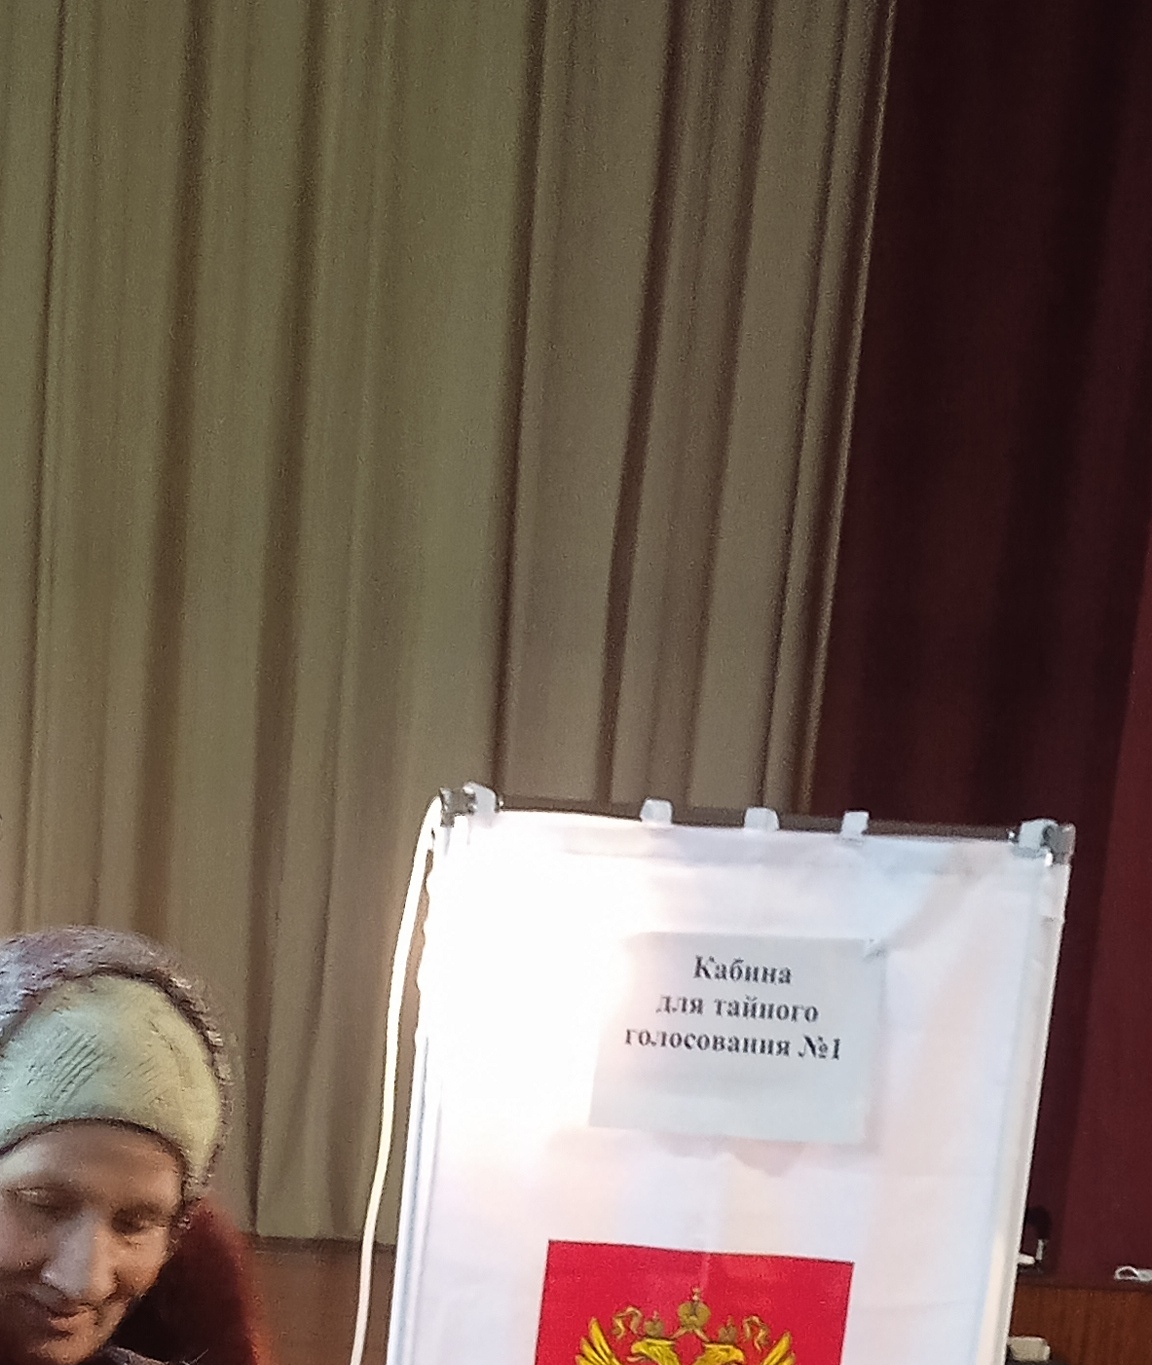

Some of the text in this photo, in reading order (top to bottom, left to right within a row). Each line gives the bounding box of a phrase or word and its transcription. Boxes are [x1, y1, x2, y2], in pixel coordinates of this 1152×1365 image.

[693, 954, 792, 985] Кабина
[655, 993, 819, 1023] для тайного
[625, 1028, 841, 1060] голосования №1
